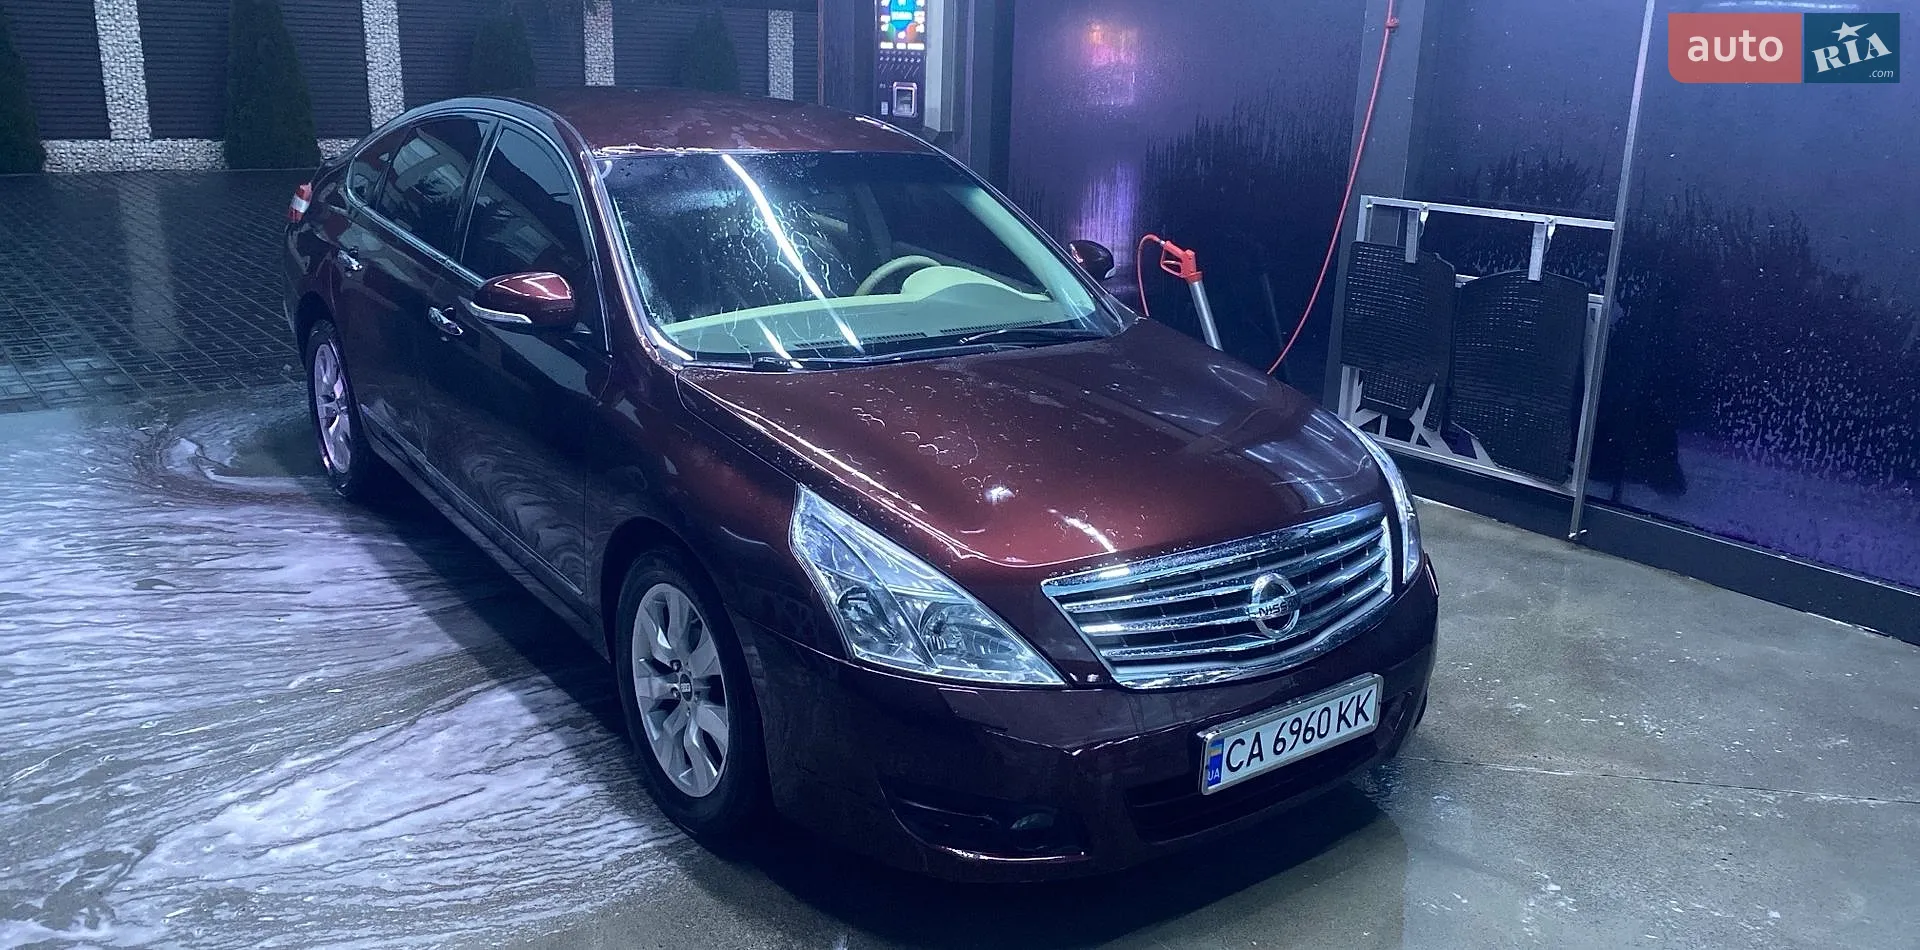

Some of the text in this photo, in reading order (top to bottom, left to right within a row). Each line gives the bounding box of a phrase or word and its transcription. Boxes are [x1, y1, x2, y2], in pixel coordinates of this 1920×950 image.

[1225, 689, 1373, 773] CA 6960 KK
[1207, 769, 1221, 781] UA
